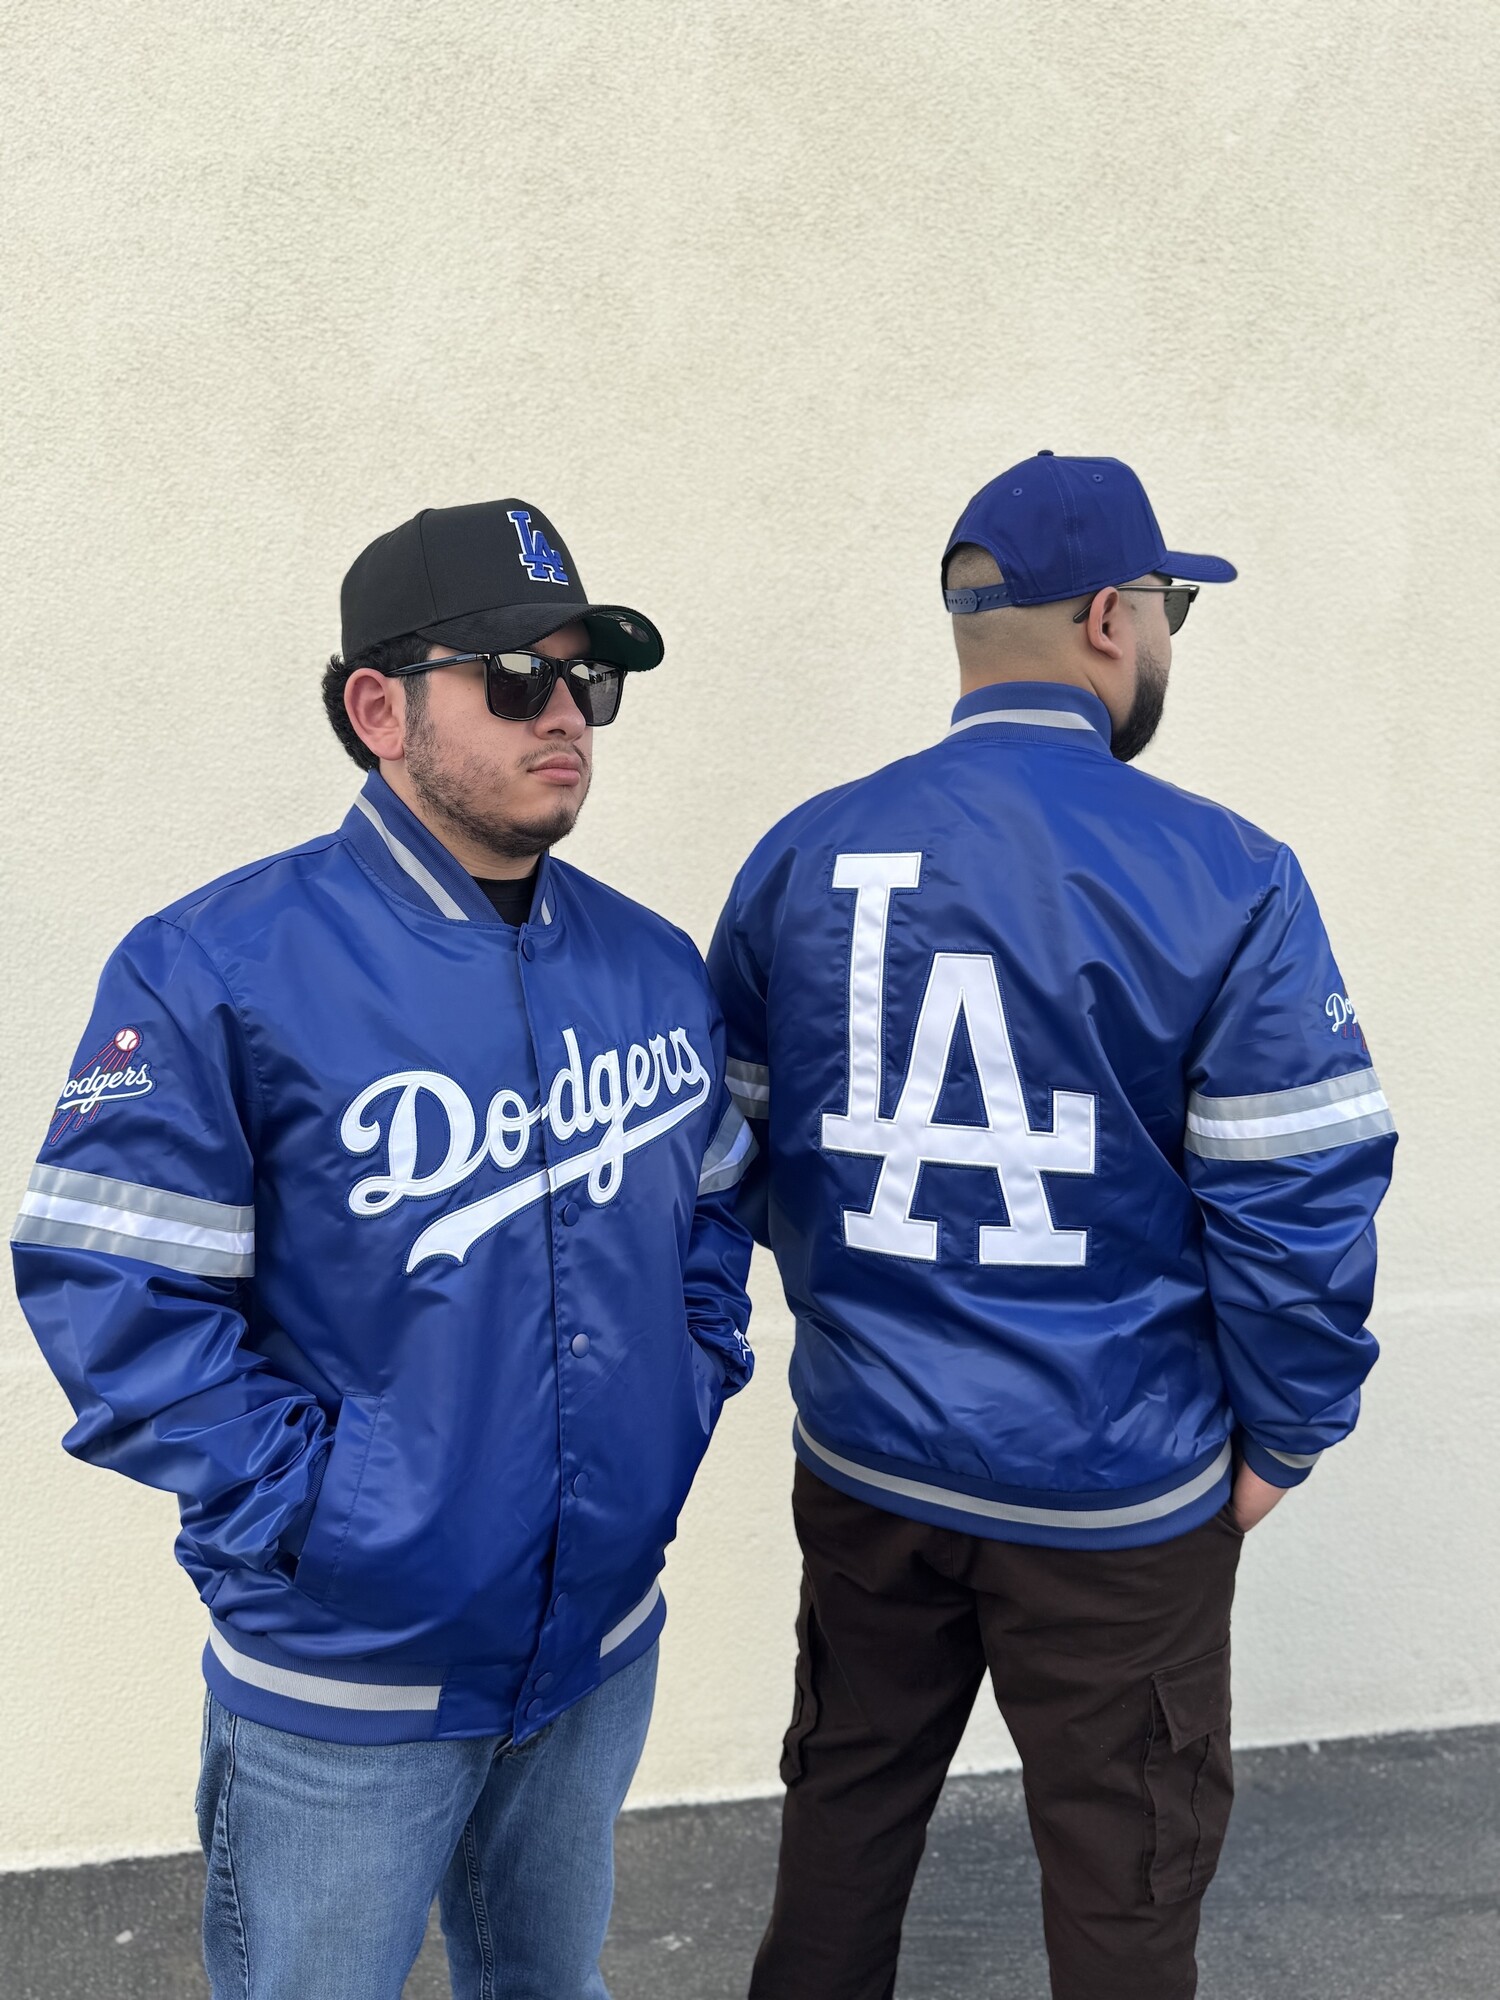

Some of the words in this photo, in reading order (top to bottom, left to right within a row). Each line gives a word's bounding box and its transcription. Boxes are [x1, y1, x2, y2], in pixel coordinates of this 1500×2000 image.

[507, 510, 569, 586] LA
[61, 1063, 153, 1114] odgers
[340, 1026, 711, 1217] Dodgers
[821, 852, 1096, 1267] LA
